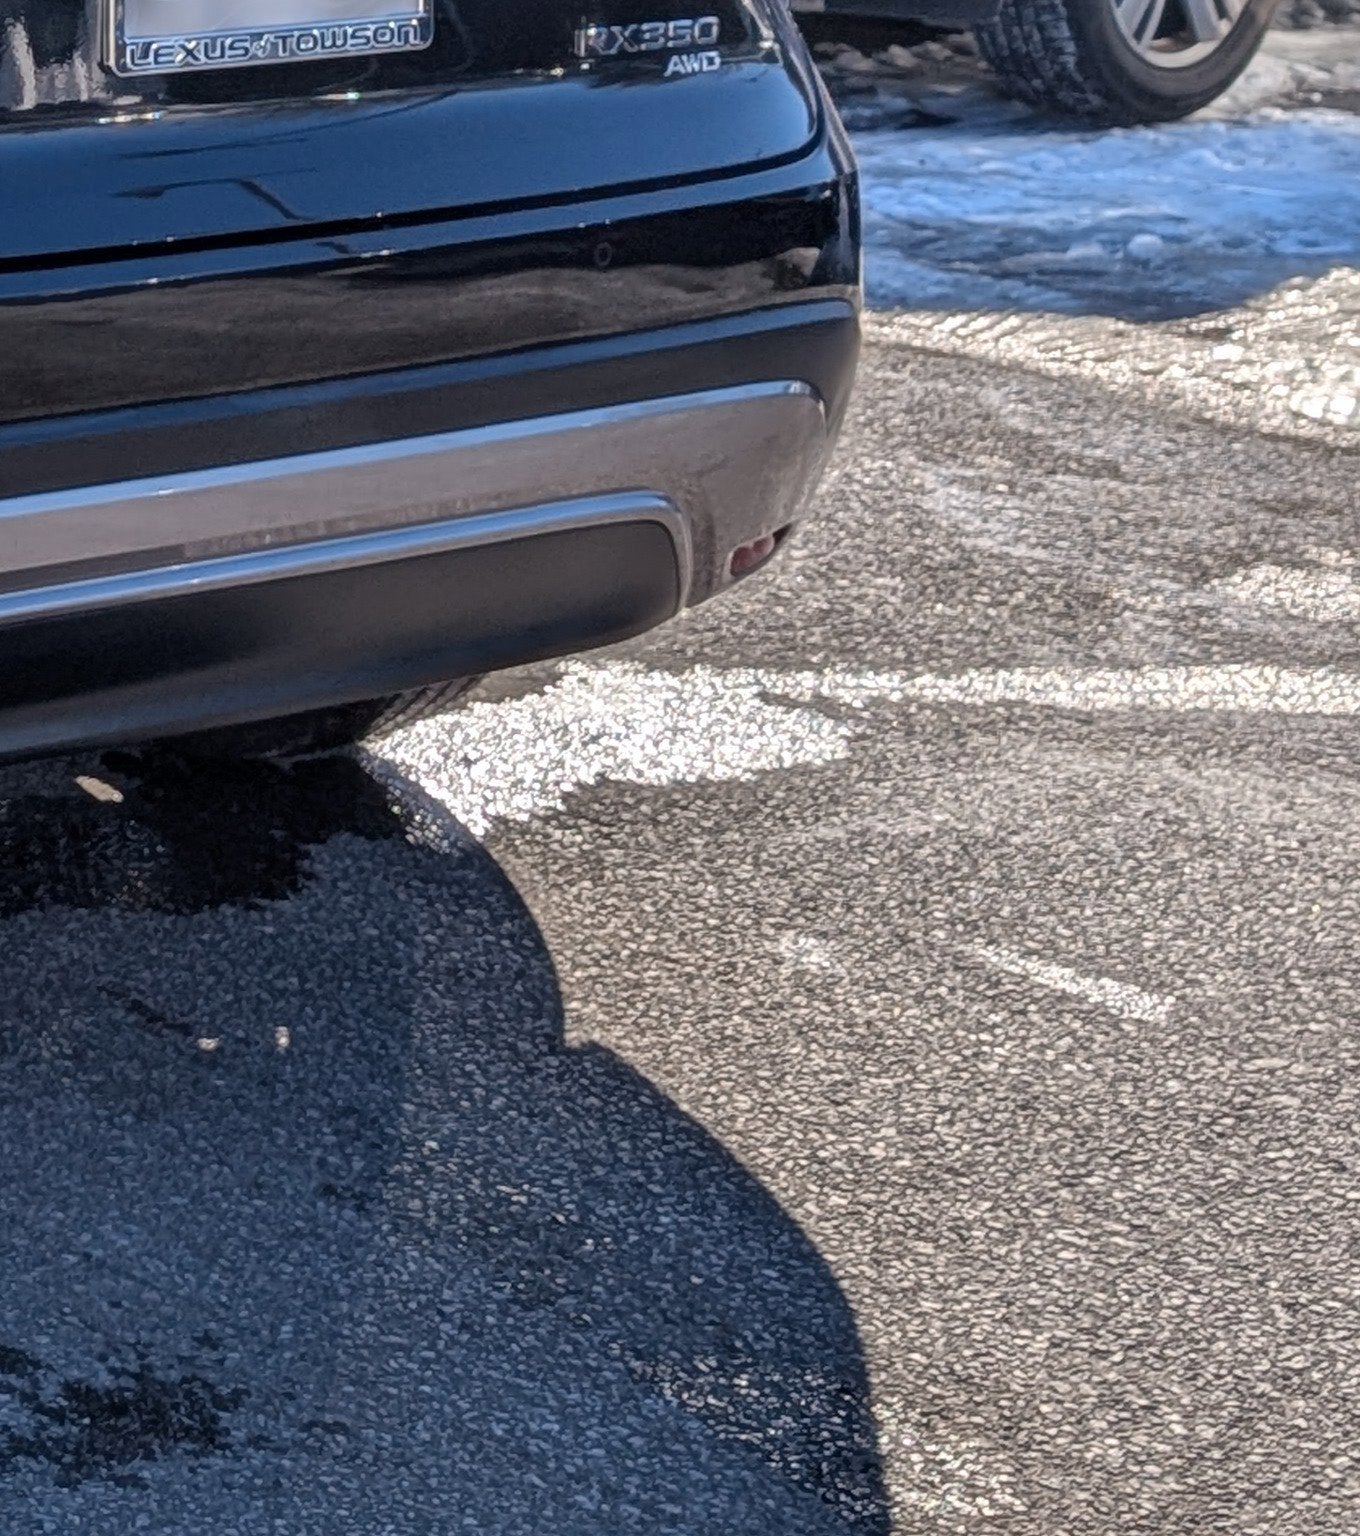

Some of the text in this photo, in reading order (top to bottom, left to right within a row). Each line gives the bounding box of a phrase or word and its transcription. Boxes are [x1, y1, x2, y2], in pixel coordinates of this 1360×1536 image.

[126, 34, 252, 71] LEXUS
[273, 19, 420, 58] TOWSON
[662, 50, 722, 78] AWD
